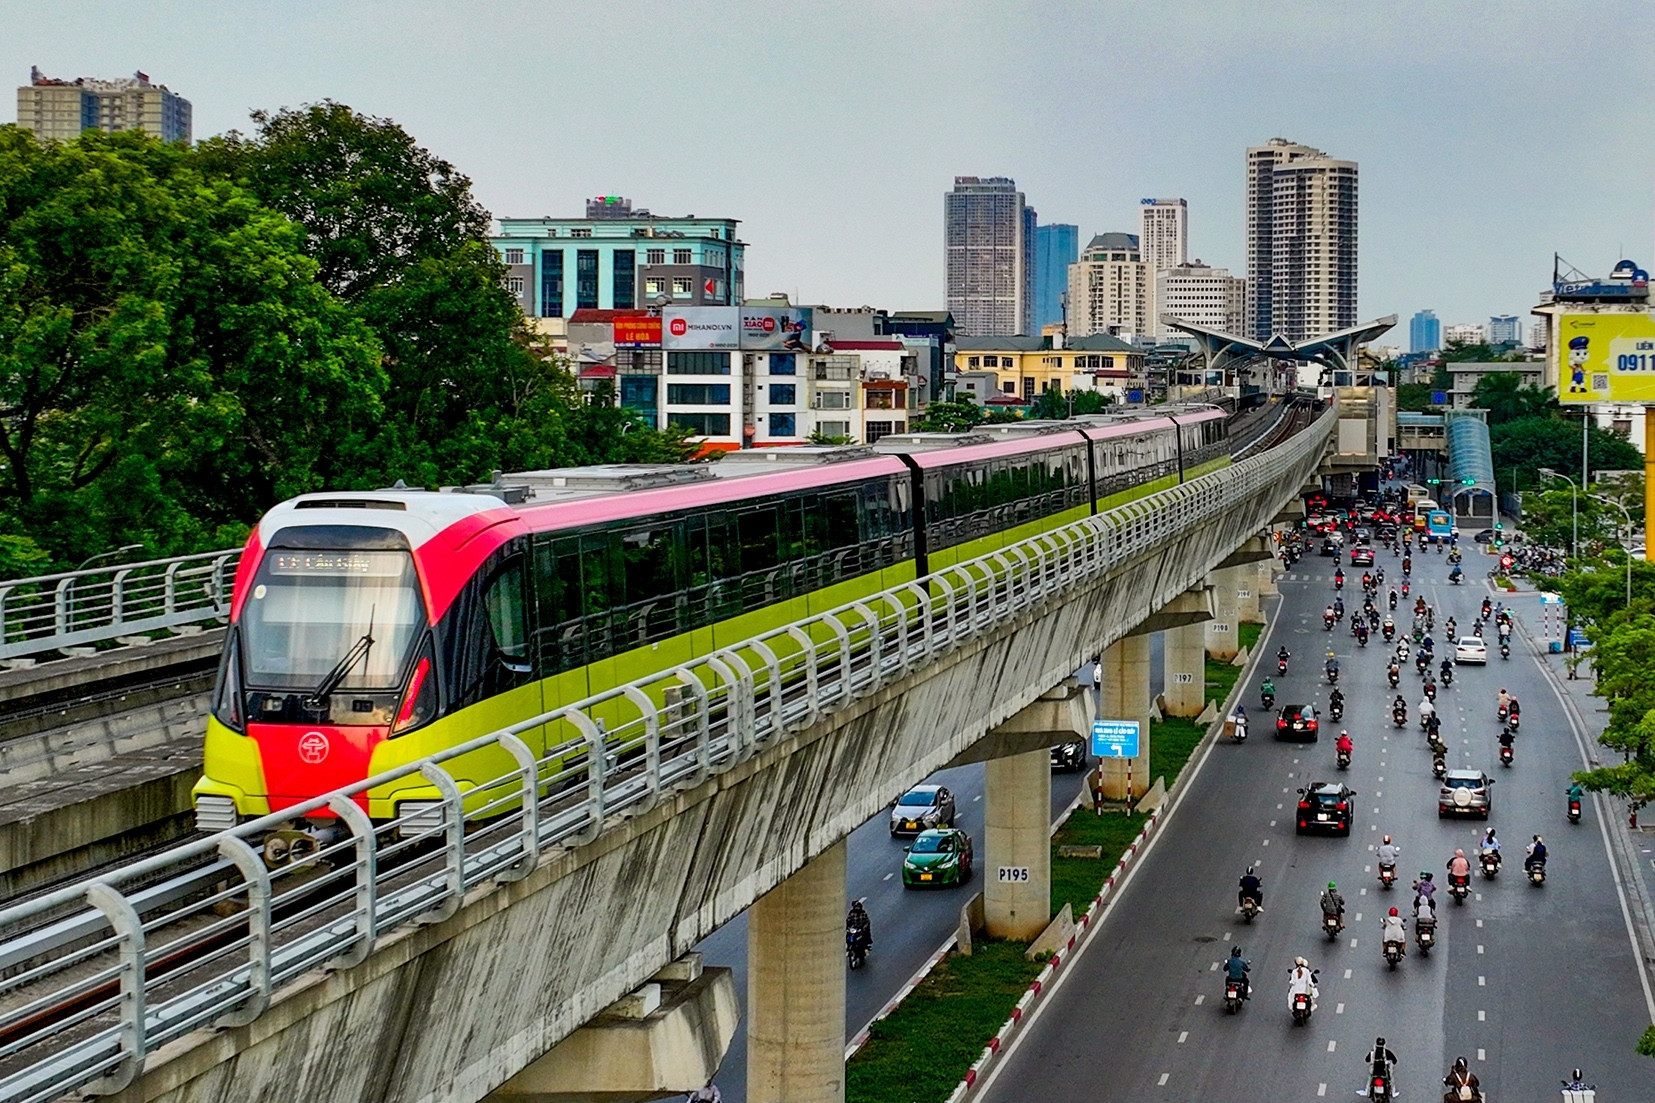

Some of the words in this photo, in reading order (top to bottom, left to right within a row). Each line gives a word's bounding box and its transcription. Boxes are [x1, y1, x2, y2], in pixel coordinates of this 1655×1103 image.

[1636, 340, 1654, 351] LIÊN
[1618, 354, 1655, 371] 0911
[999, 868, 1028, 881] P195
